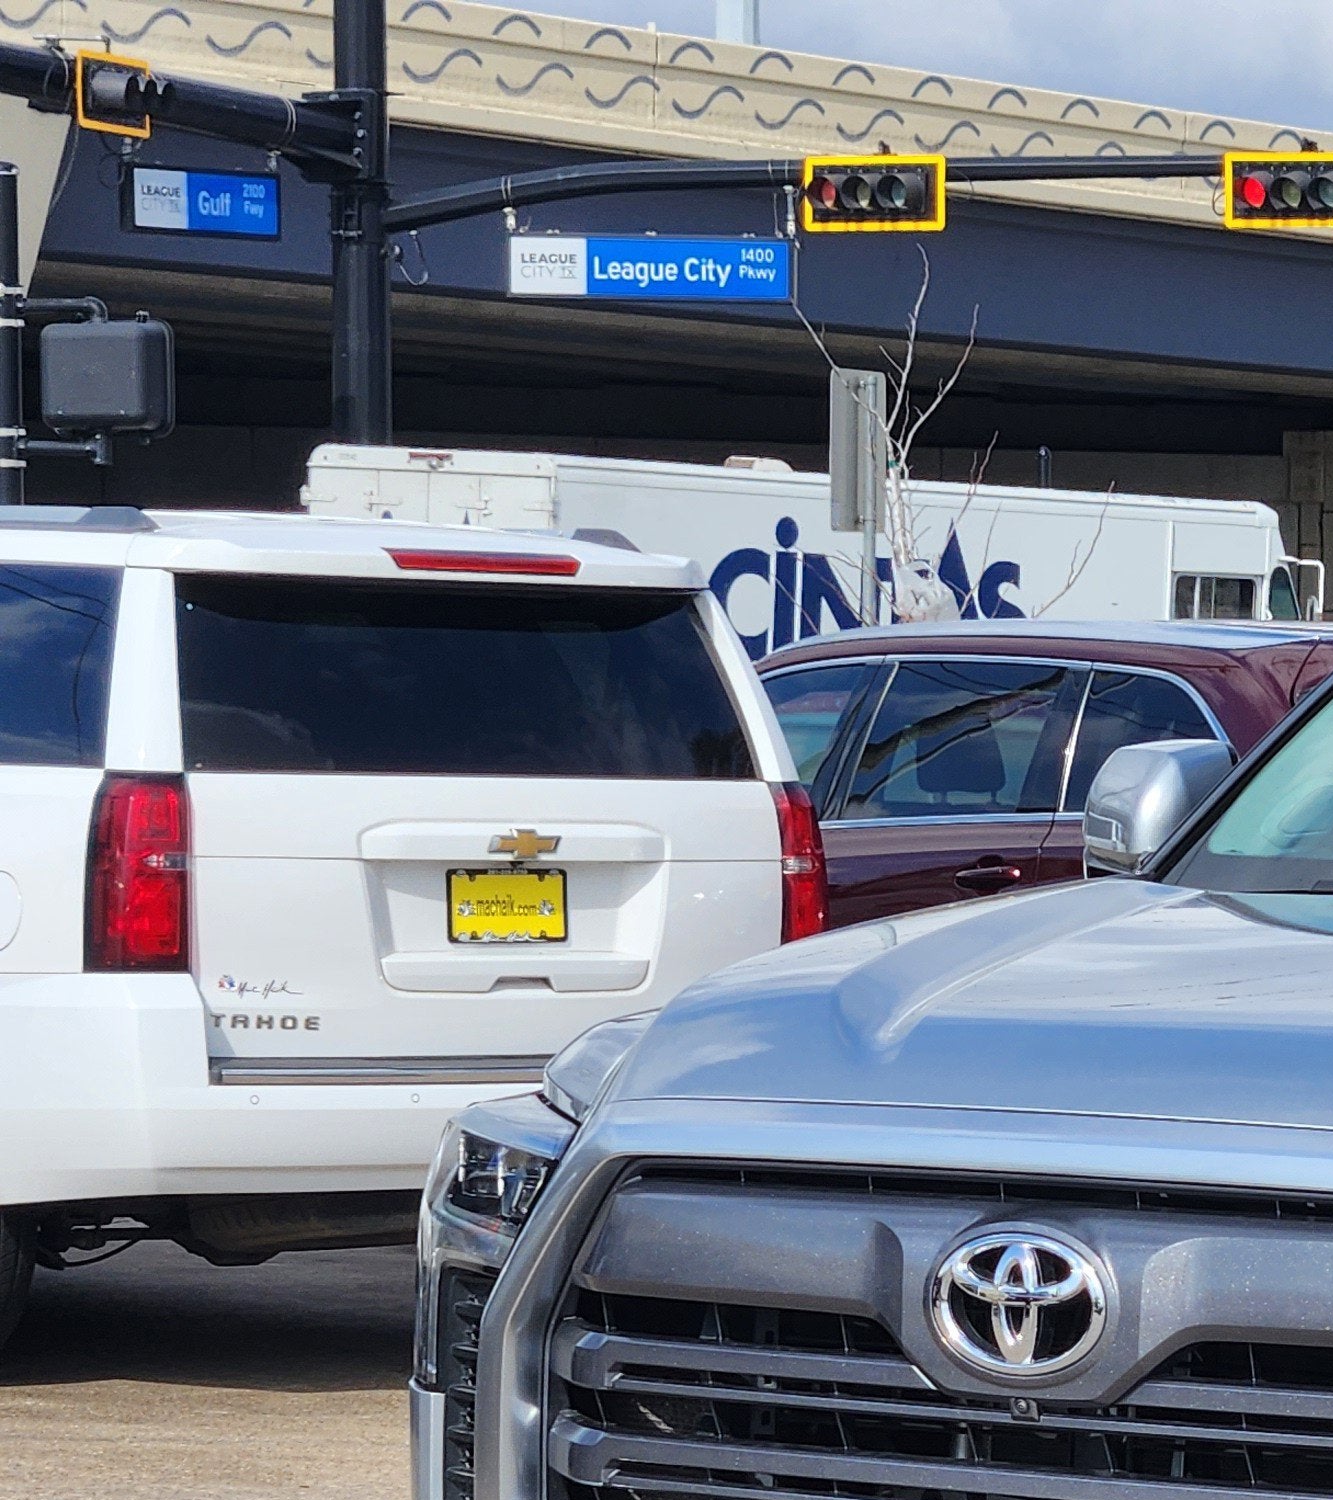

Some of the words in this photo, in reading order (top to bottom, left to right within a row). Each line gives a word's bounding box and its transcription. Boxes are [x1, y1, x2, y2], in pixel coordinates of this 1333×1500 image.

[141, 184, 181, 198] LEAGUE
[198, 190, 231, 217] Gulf
[244, 200, 264, 219] Fwy
[520, 253, 577, 264] LEAGUE
[740, 248, 775, 263] 1400
[520, 265, 555, 278] CITY
[593, 256, 678, 288] League
[684, 257, 732, 288] City
[738, 264, 776, 282] Pkwy
[210, 1013, 321, 1031] TAHOE
